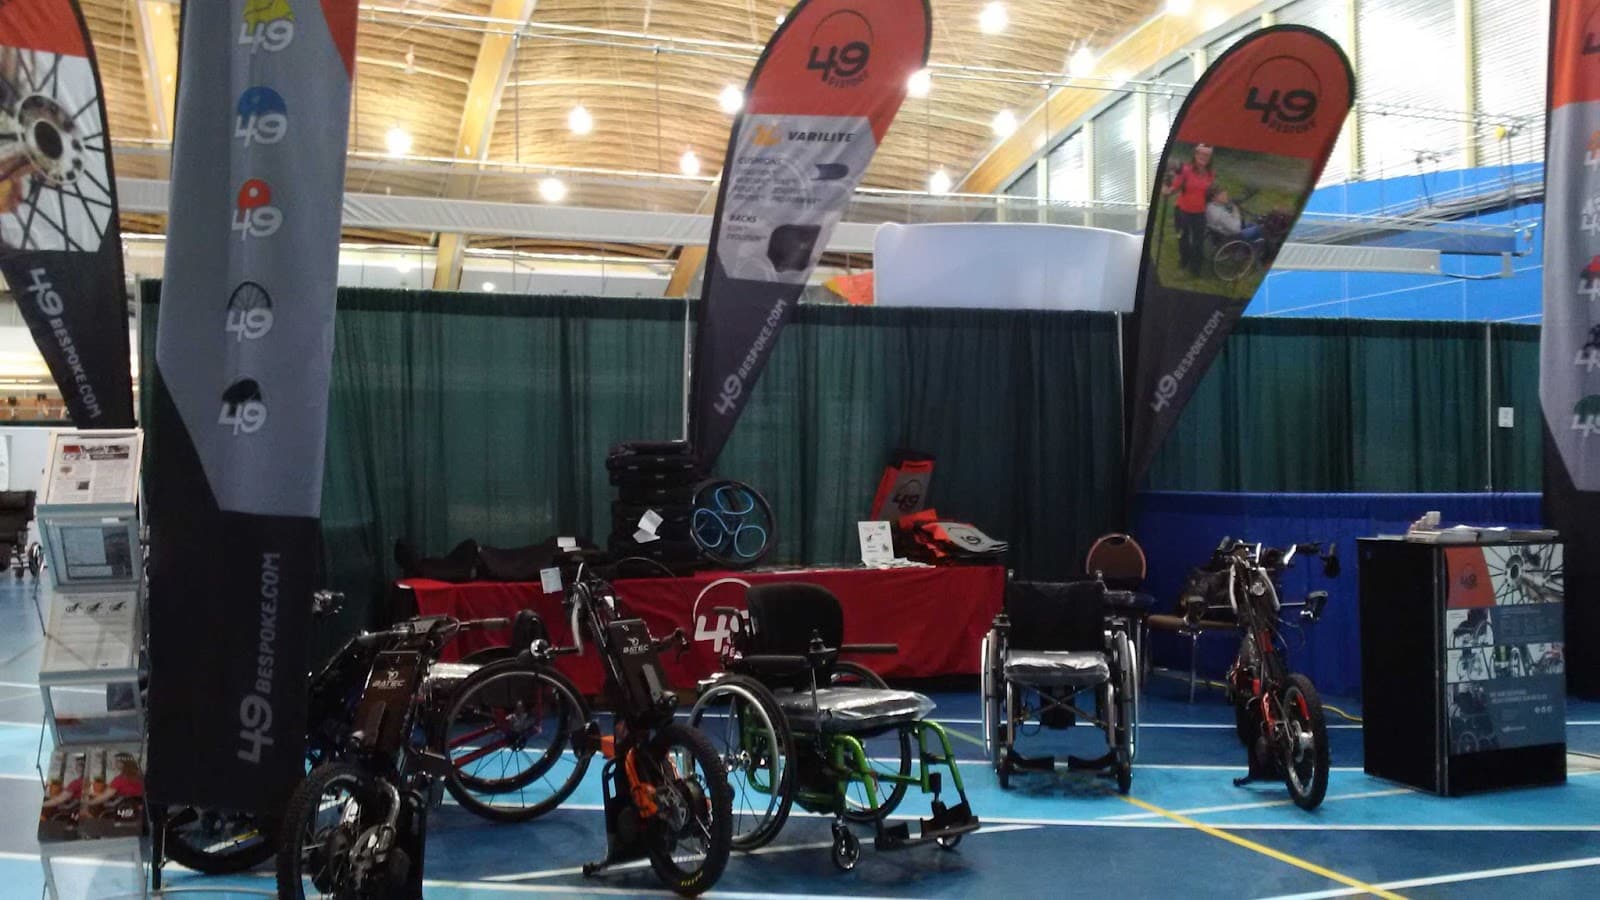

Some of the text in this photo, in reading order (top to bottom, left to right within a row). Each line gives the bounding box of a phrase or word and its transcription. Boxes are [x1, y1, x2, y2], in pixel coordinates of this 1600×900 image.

[238, 19, 294, 55] 49
[807, 41, 870, 81] 49
[1244, 88, 1317, 124] 49
[234, 113, 288, 147] 49
[788, 130, 856, 142] VARILITE
[231, 206, 283, 240] 49
[729, 215, 757, 223] BACKS
[225, 307, 274, 342] 49
[27, 267, 64, 317] 49
[50, 317, 102, 419] BESPOKE.COM
[713, 298, 787, 415] 49 BESPOKE.COM
[1149, 309, 1225, 412] 49 BESPOKE.COM
[218, 402, 267, 435] 49
[237, 552, 281, 764] 49 BESPOKE.COM
[623, 644, 649, 655] BATEC
